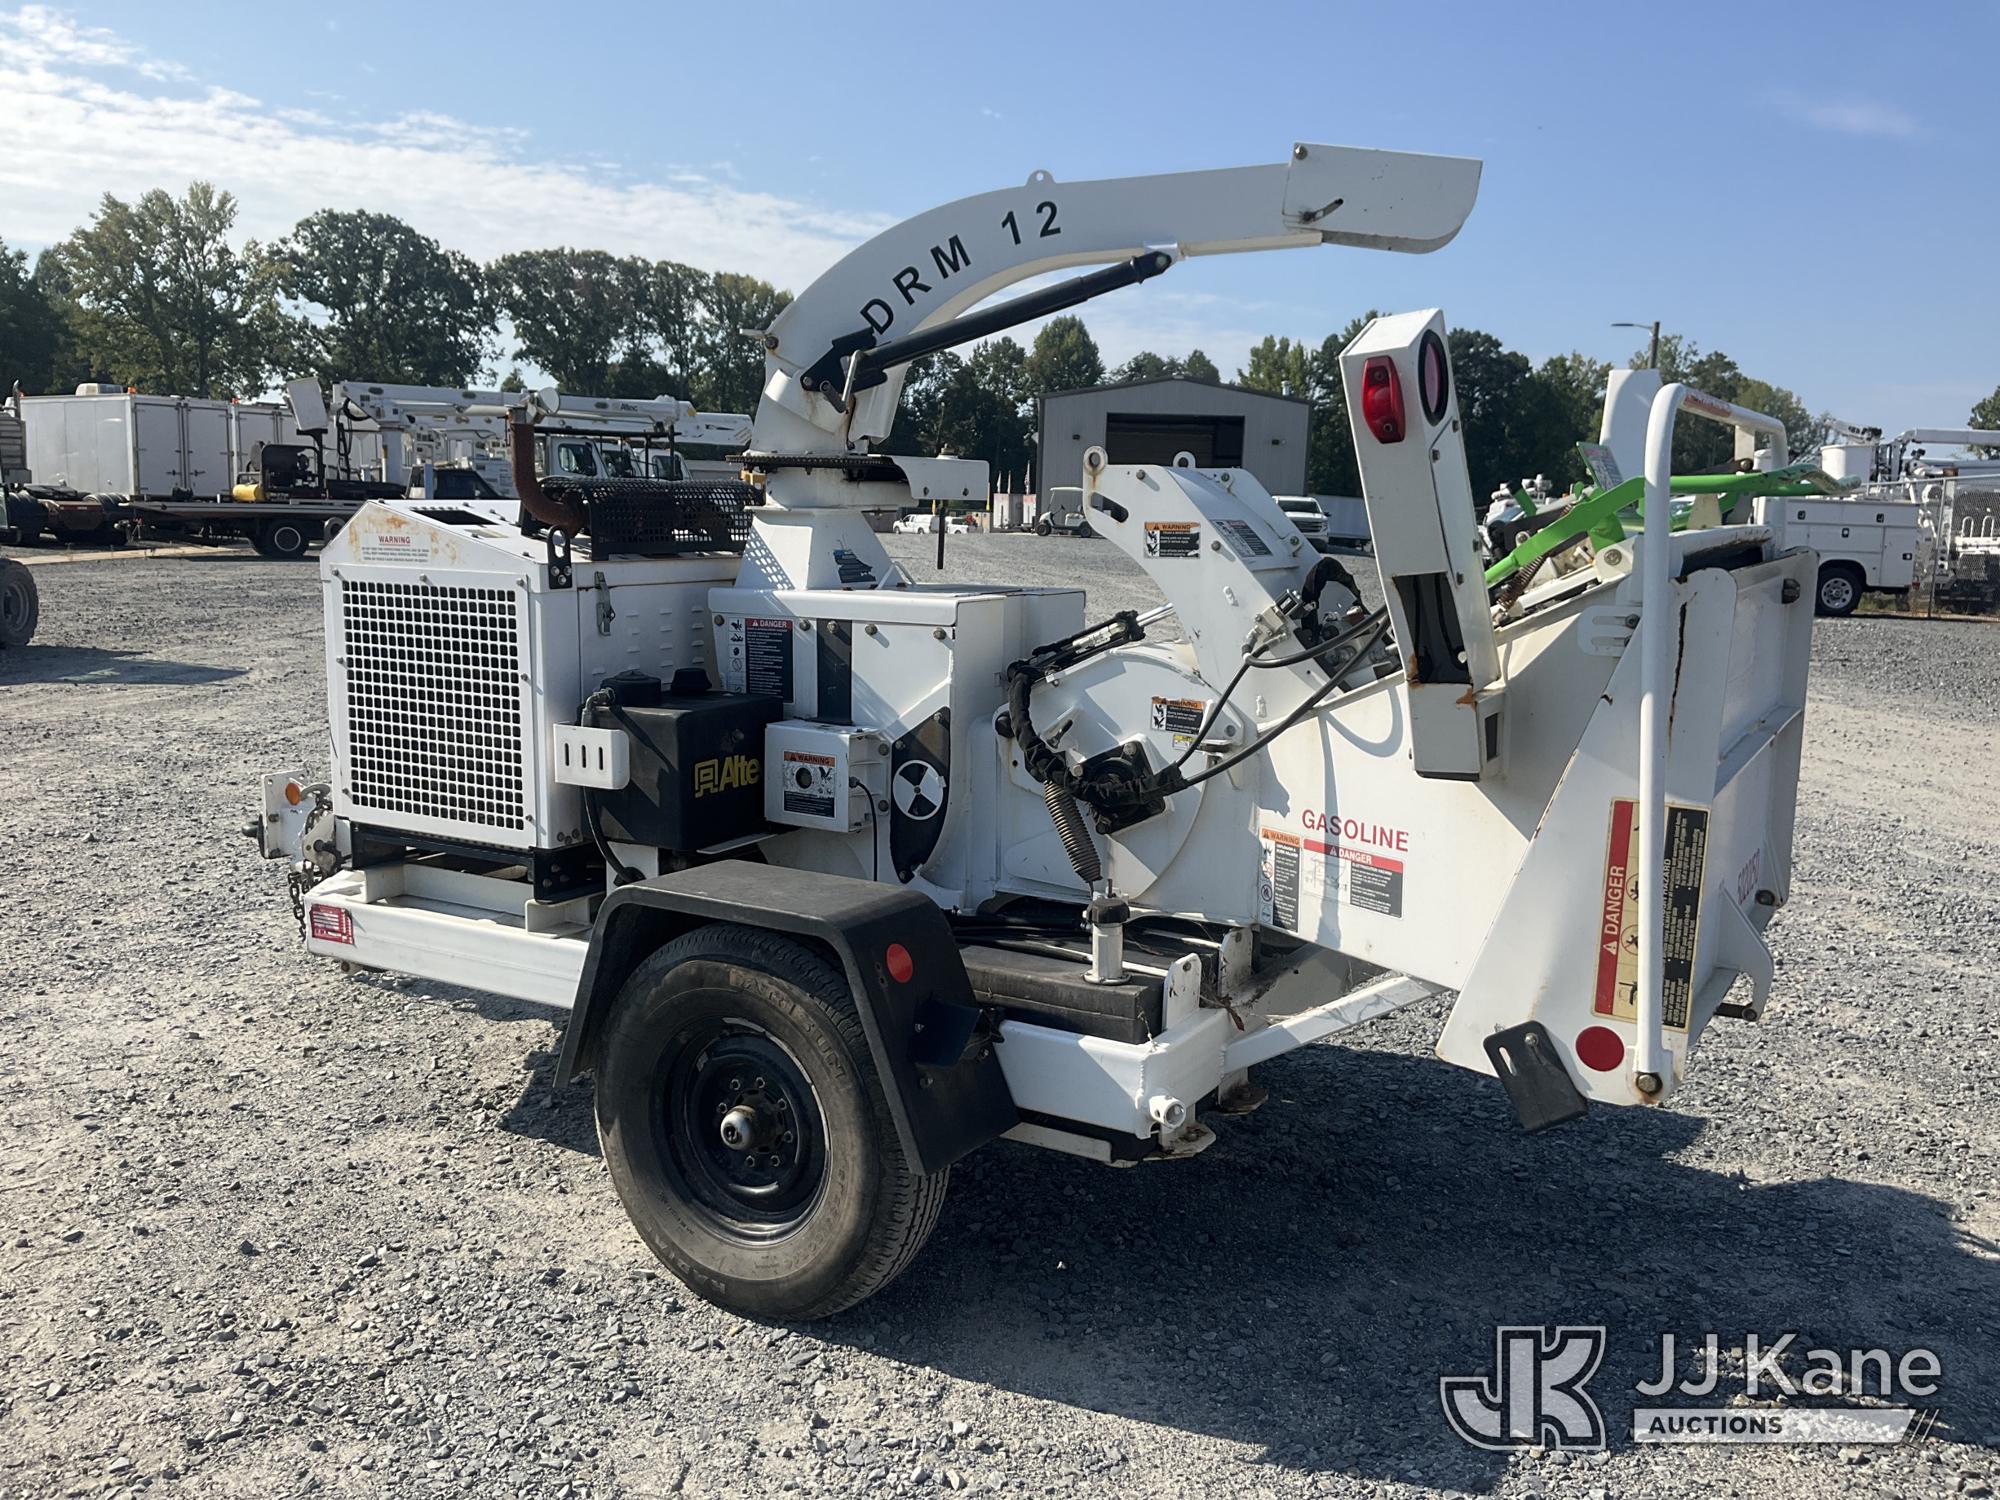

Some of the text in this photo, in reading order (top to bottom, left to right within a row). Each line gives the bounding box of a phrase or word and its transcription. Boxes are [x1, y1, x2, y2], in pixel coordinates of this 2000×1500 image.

[859, 201, 1062, 335] DRM 12
[378, 535, 411, 544] WARNING
[760, 620, 788, 628] DANGER
[797, 753, 830, 765] WARNING
[719, 754, 761, 792] Alte
[1270, 831, 1300, 846] WARNING
[1301, 809, 1409, 853] GASOLINE
[1338, 848, 1373, 865] DANGER
[1603, 865, 1625, 936] DANGER
